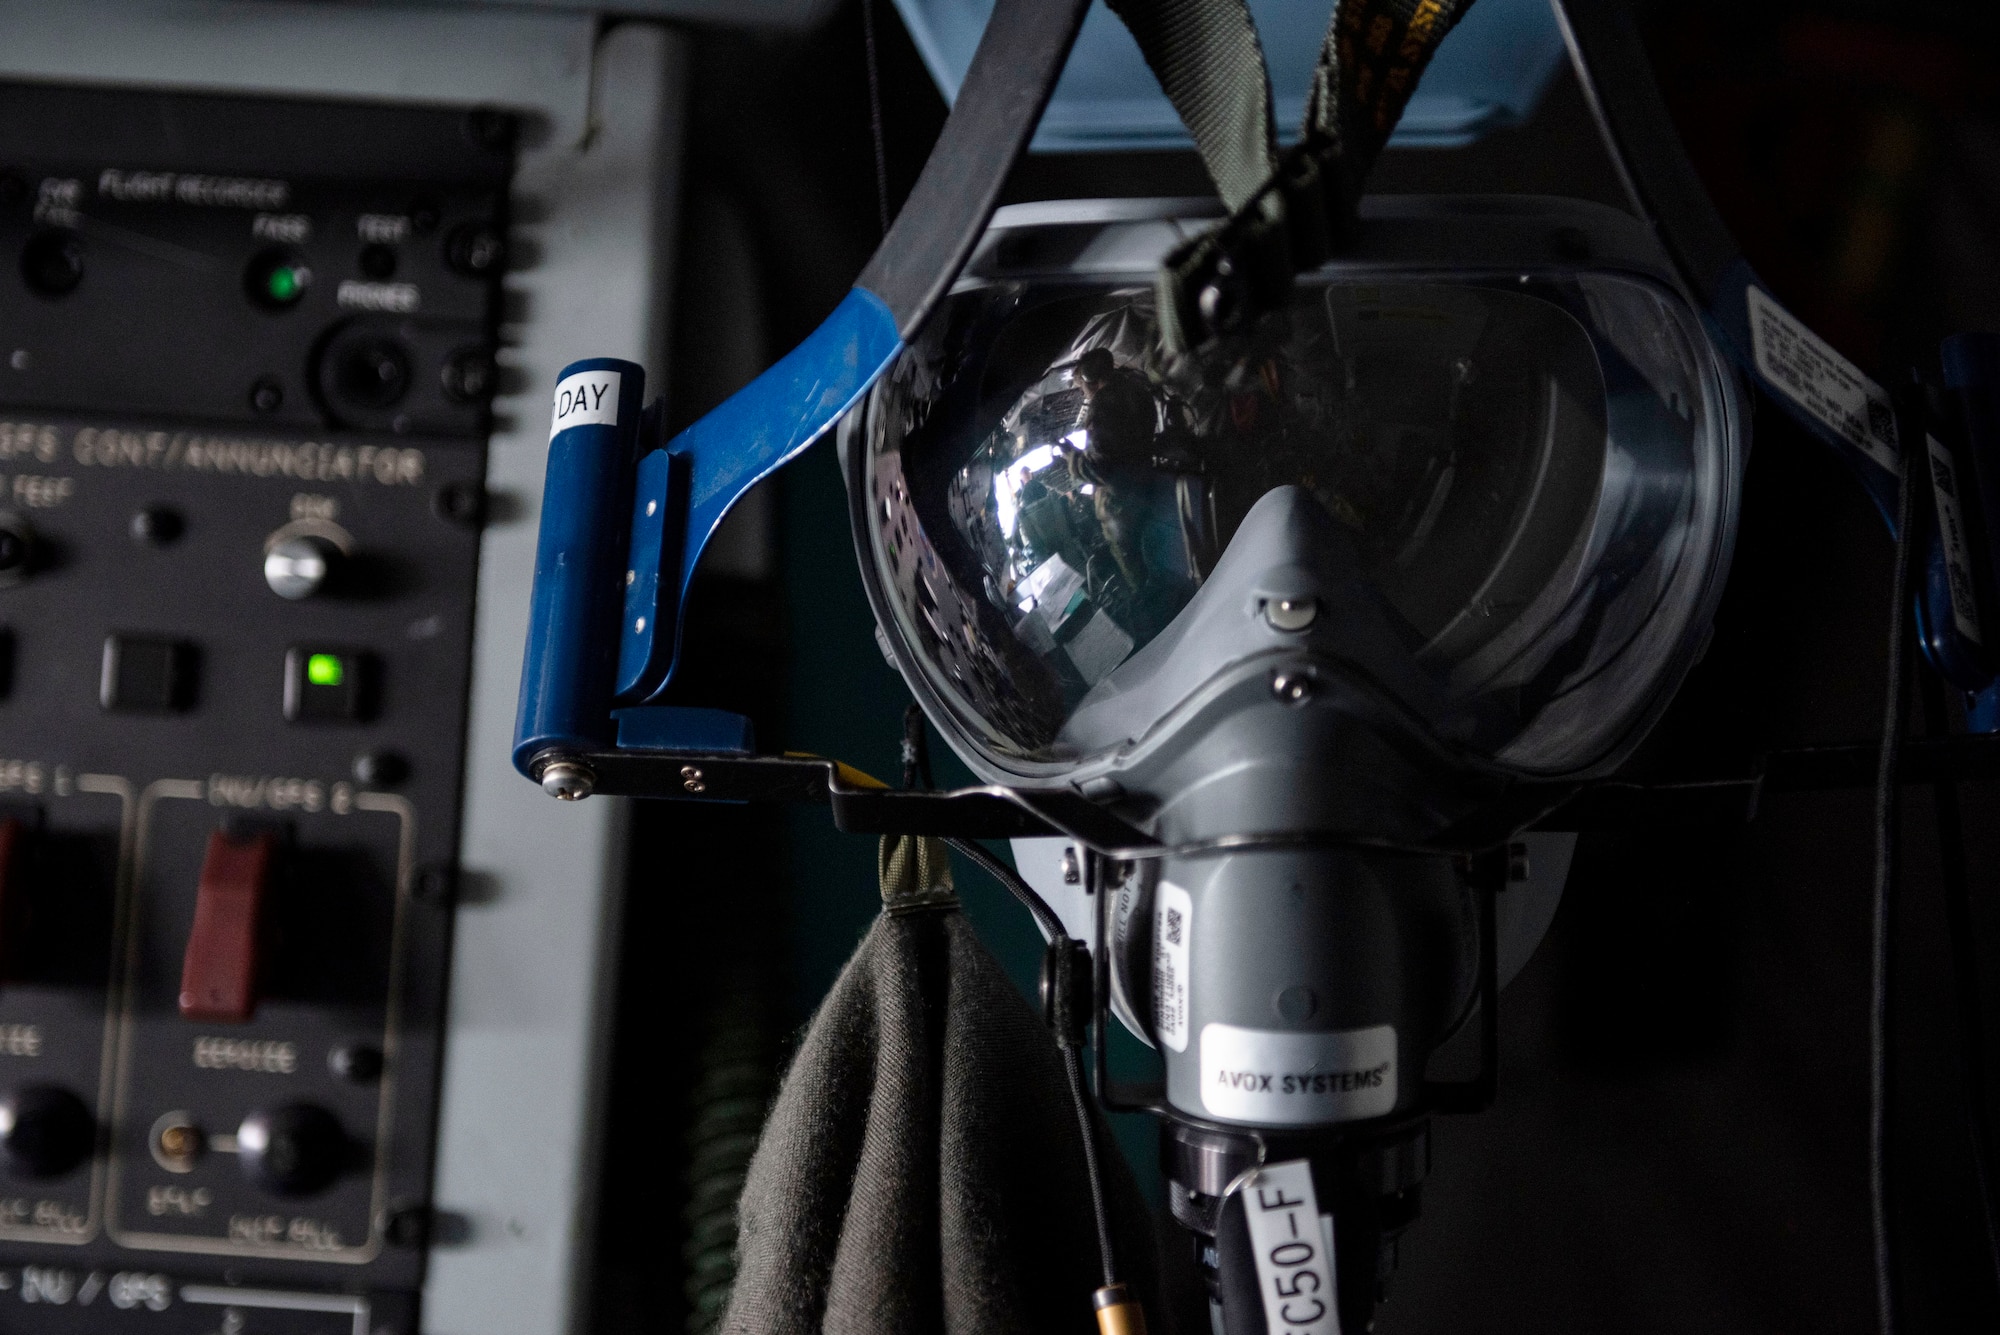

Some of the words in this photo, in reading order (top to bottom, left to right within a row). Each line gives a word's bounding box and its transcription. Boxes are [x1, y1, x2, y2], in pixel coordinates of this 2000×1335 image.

[558, 383, 609, 419] DAY
[1218, 1069, 1273, 1094] AVOX
[1259, 1189, 1326, 1335] C50-F
